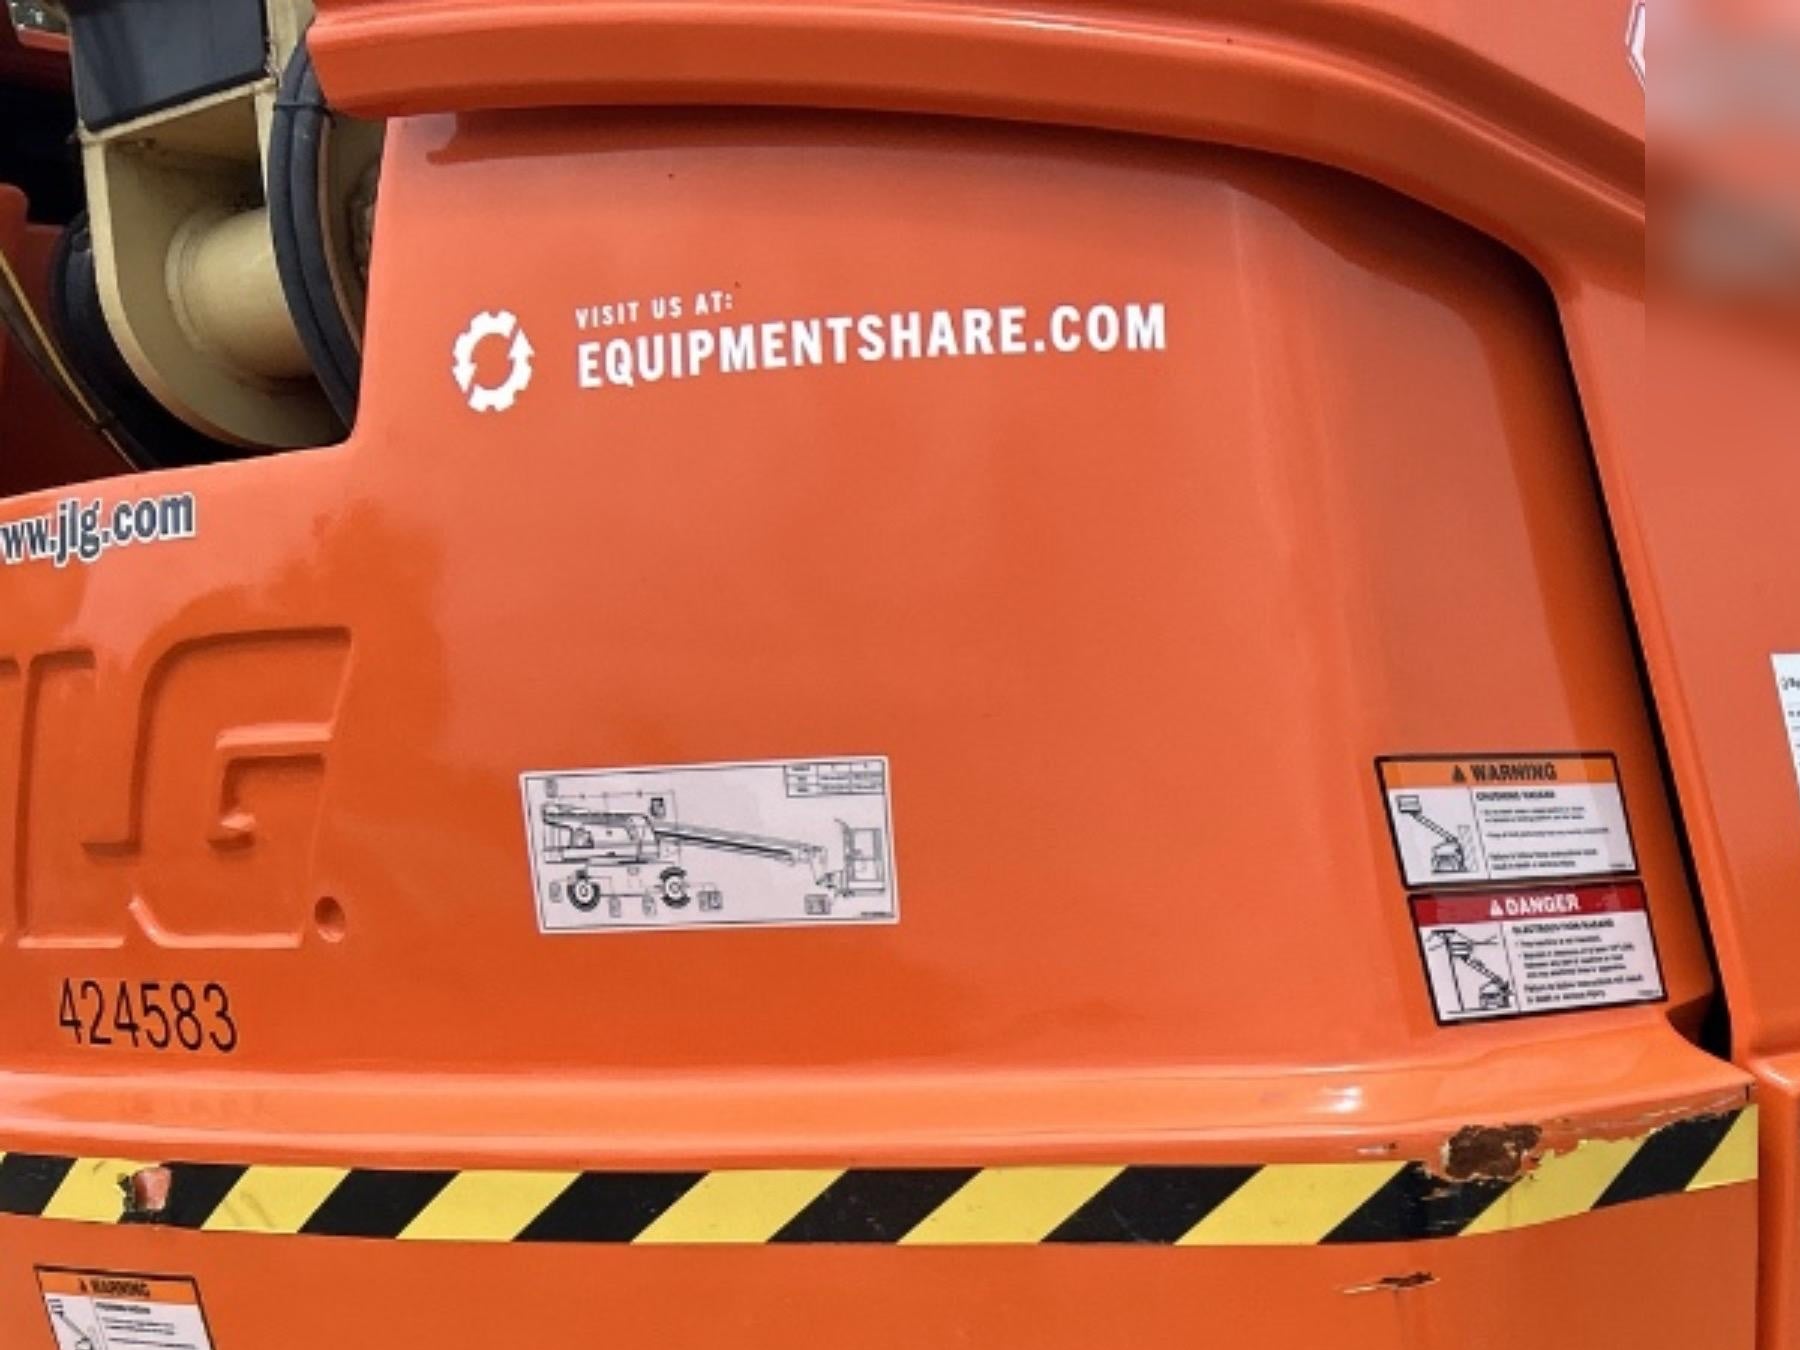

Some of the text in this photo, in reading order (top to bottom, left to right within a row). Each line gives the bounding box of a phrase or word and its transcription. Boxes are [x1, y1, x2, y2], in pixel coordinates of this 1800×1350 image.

[575, 290, 733, 329] VISIT US AT:
[577, 303, 1166, 389] EQUIPMENTSHARE.COM
[0, 493, 195, 567] ww.jlg.com
[1470, 762, 1557, 782] WARNING
[1505, 893, 1580, 915] DANGER
[59, 977, 238, 1053] 424583
